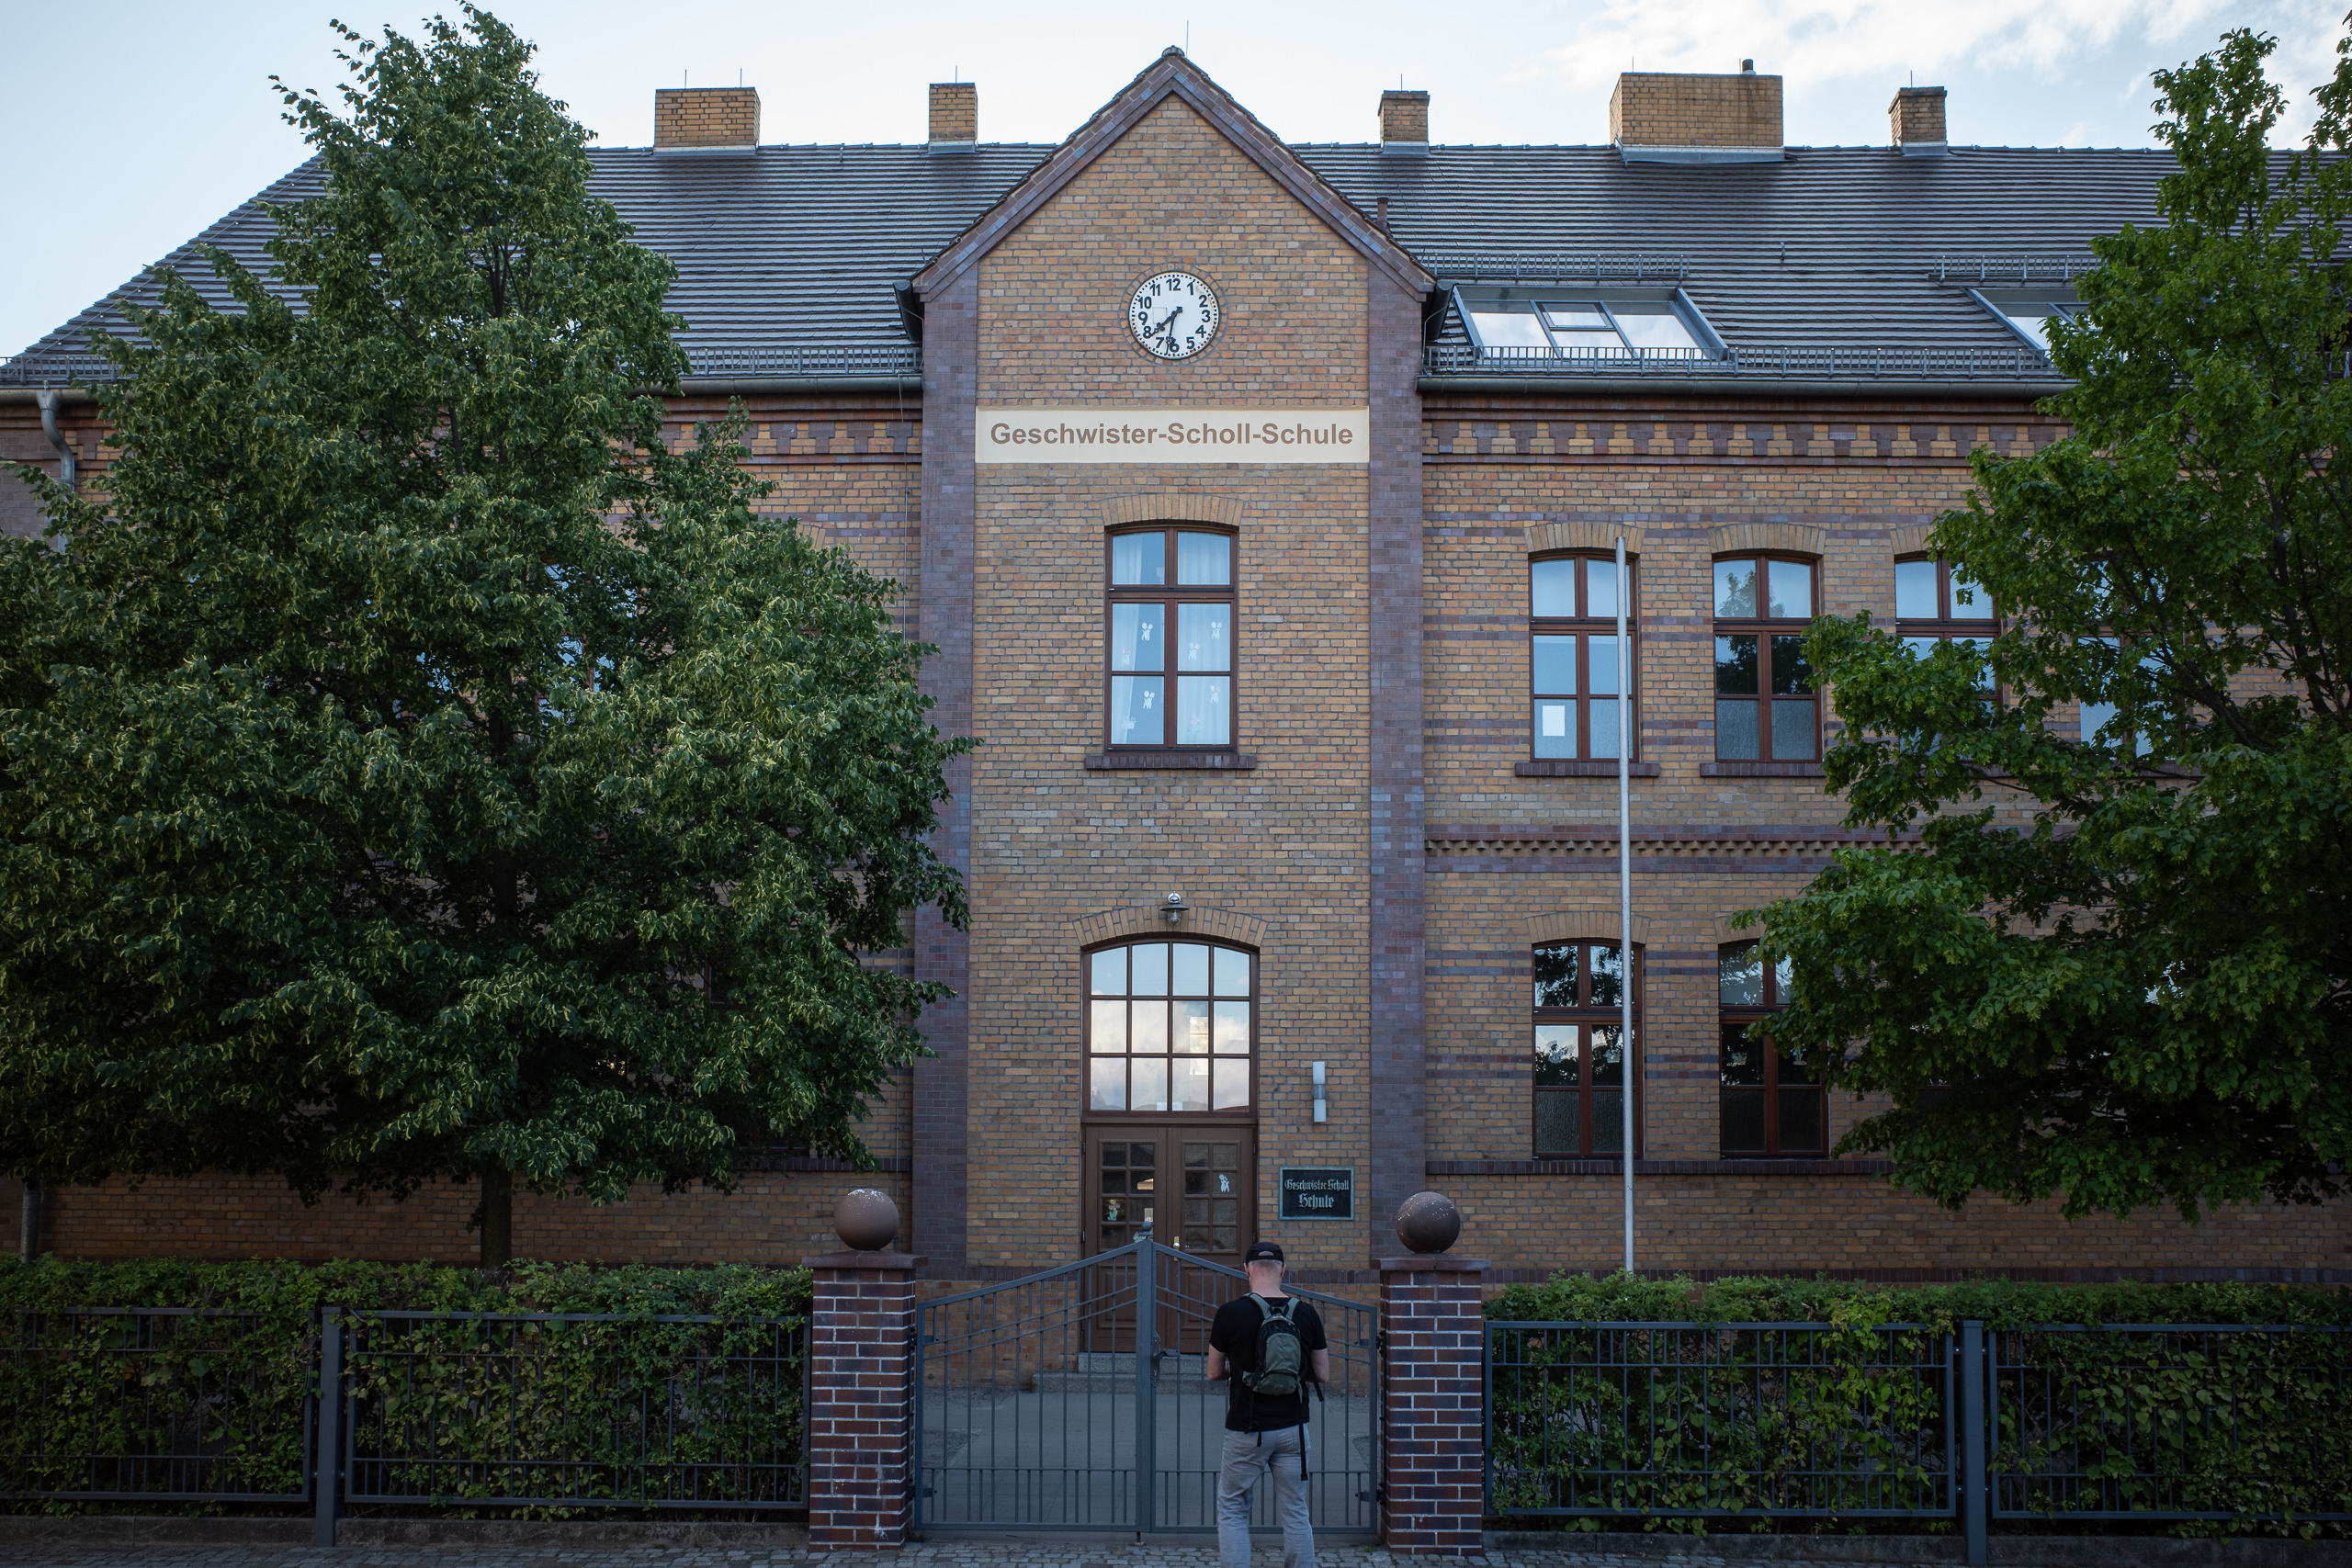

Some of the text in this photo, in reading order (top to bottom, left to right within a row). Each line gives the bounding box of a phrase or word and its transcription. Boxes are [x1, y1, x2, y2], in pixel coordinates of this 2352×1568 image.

[1150, 284, 1160, 296] 11
[1166, 278, 1182, 291] 12
[1187, 282, 1194, 296] 1
[1138, 296, 1152, 309] 10
[1199, 295, 1208, 308] 2
[1138, 311, 1148, 325] 9
[1202, 310, 1211, 322] 3
[1143, 326, 1152, 338] 8
[1195, 325, 1206, 338] 4
[1156, 337, 1165, 348] 7
[1169, 338, 1180, 353] 6
[1187, 337, 1194, 349] 5
[990, 423, 1353, 445] Geschwister-Scholl-Schule
[1328, 1179, 1350, 1191] Scholl
[1298, 1193, 1334, 1209] Schule
